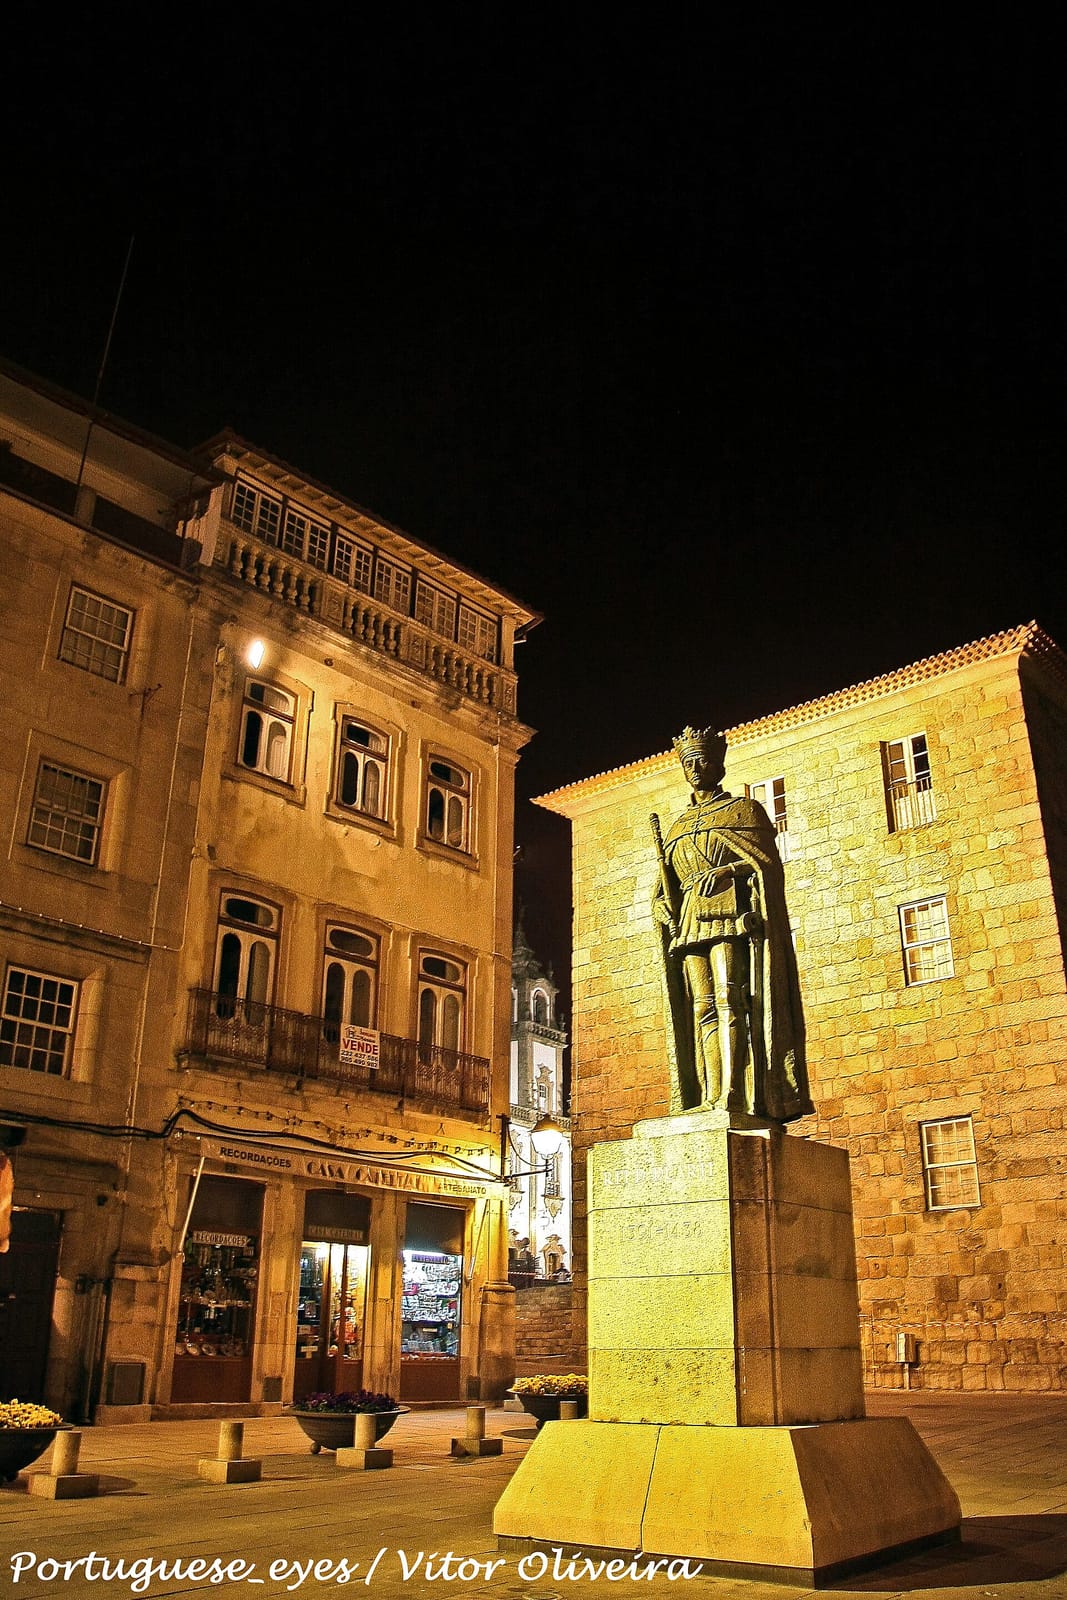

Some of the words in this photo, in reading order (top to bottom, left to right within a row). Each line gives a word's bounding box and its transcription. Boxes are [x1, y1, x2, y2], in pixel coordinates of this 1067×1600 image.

[342, 1038, 379, 1055] VENDE
[306, 1160, 345, 1180] CASA
[438, 1182, 487, 1195] ARTESANATO
